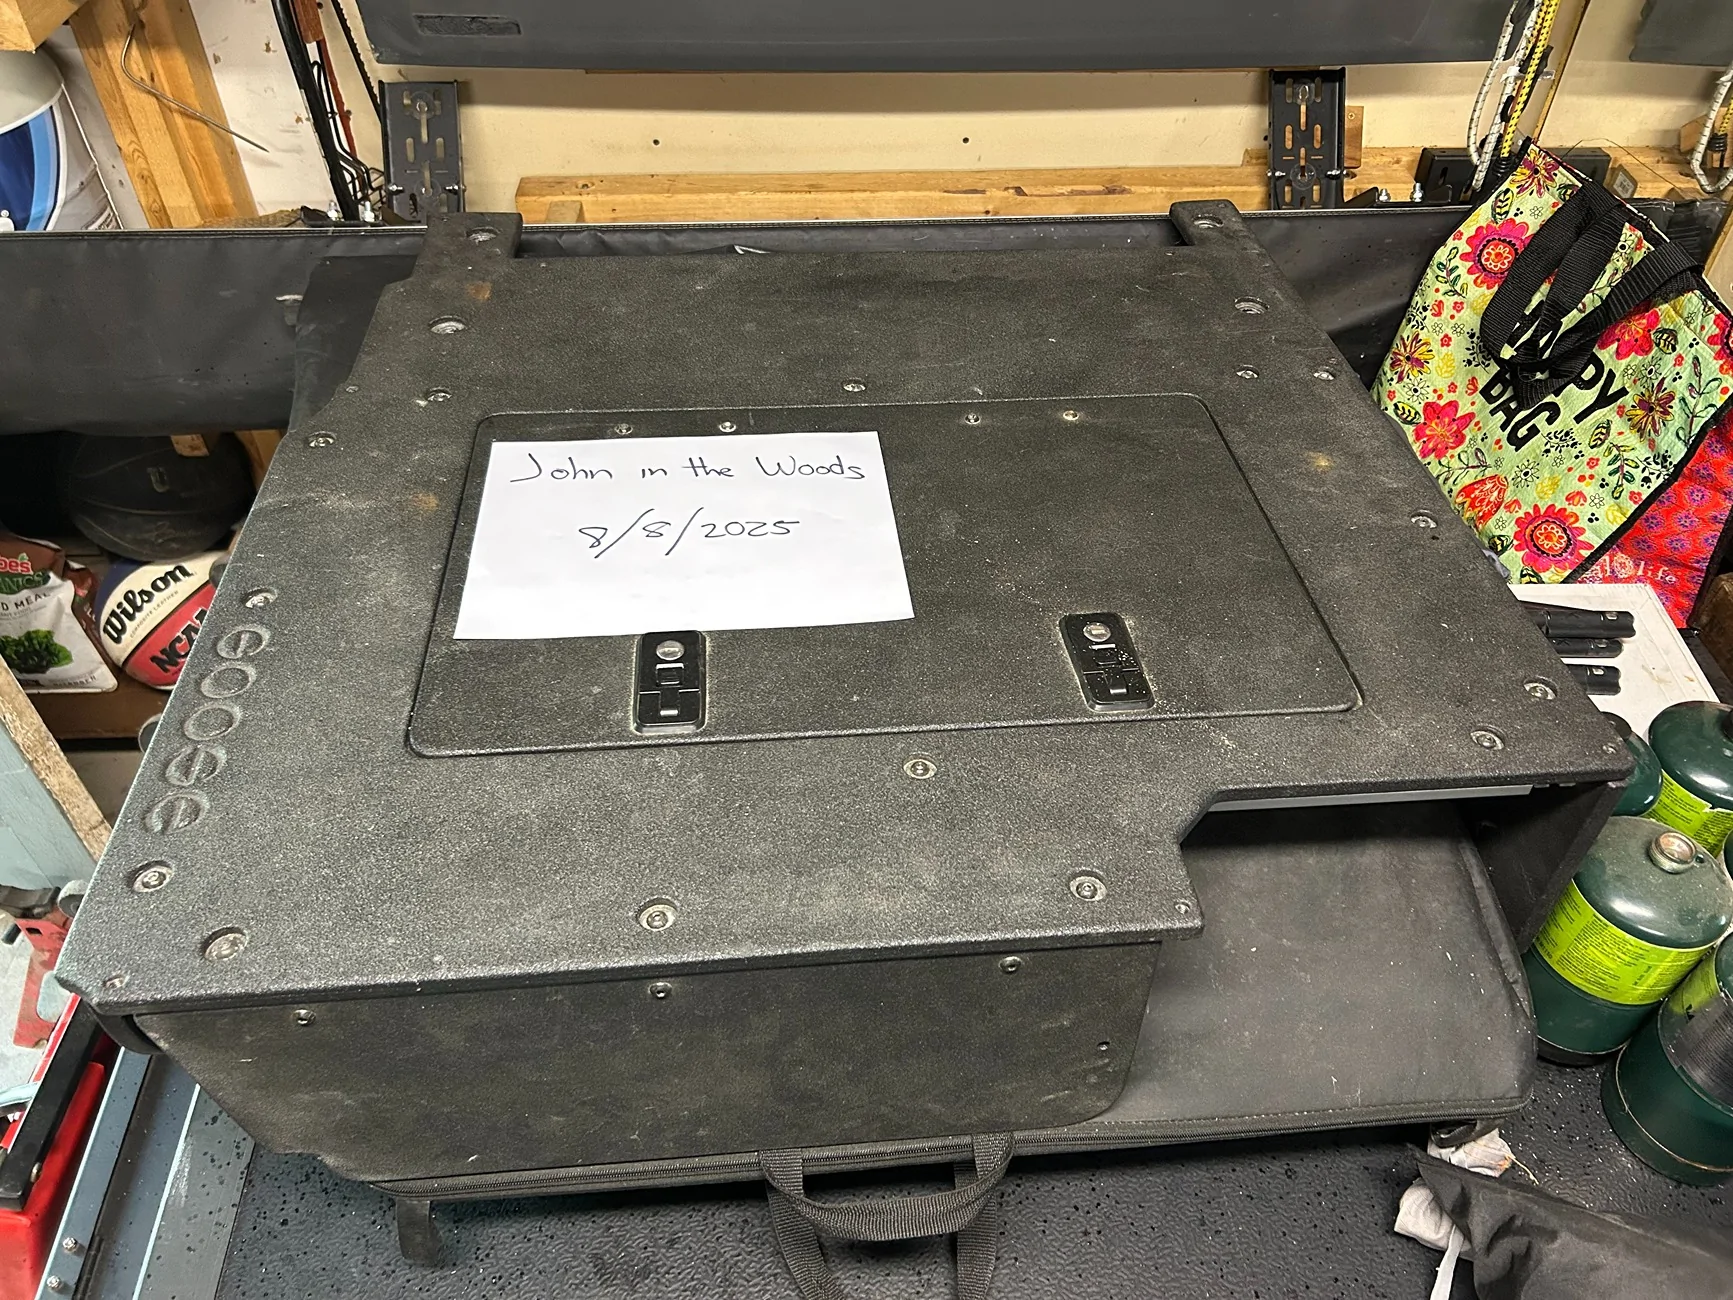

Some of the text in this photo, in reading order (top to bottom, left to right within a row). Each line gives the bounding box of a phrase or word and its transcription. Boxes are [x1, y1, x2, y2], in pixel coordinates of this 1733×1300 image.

[1479, 366, 1561, 452] BAG
[510, 453, 866, 483] John in the Woods
[578, 506, 801, 559] 8/8/2025
[103, 565, 194, 644] Wilson
